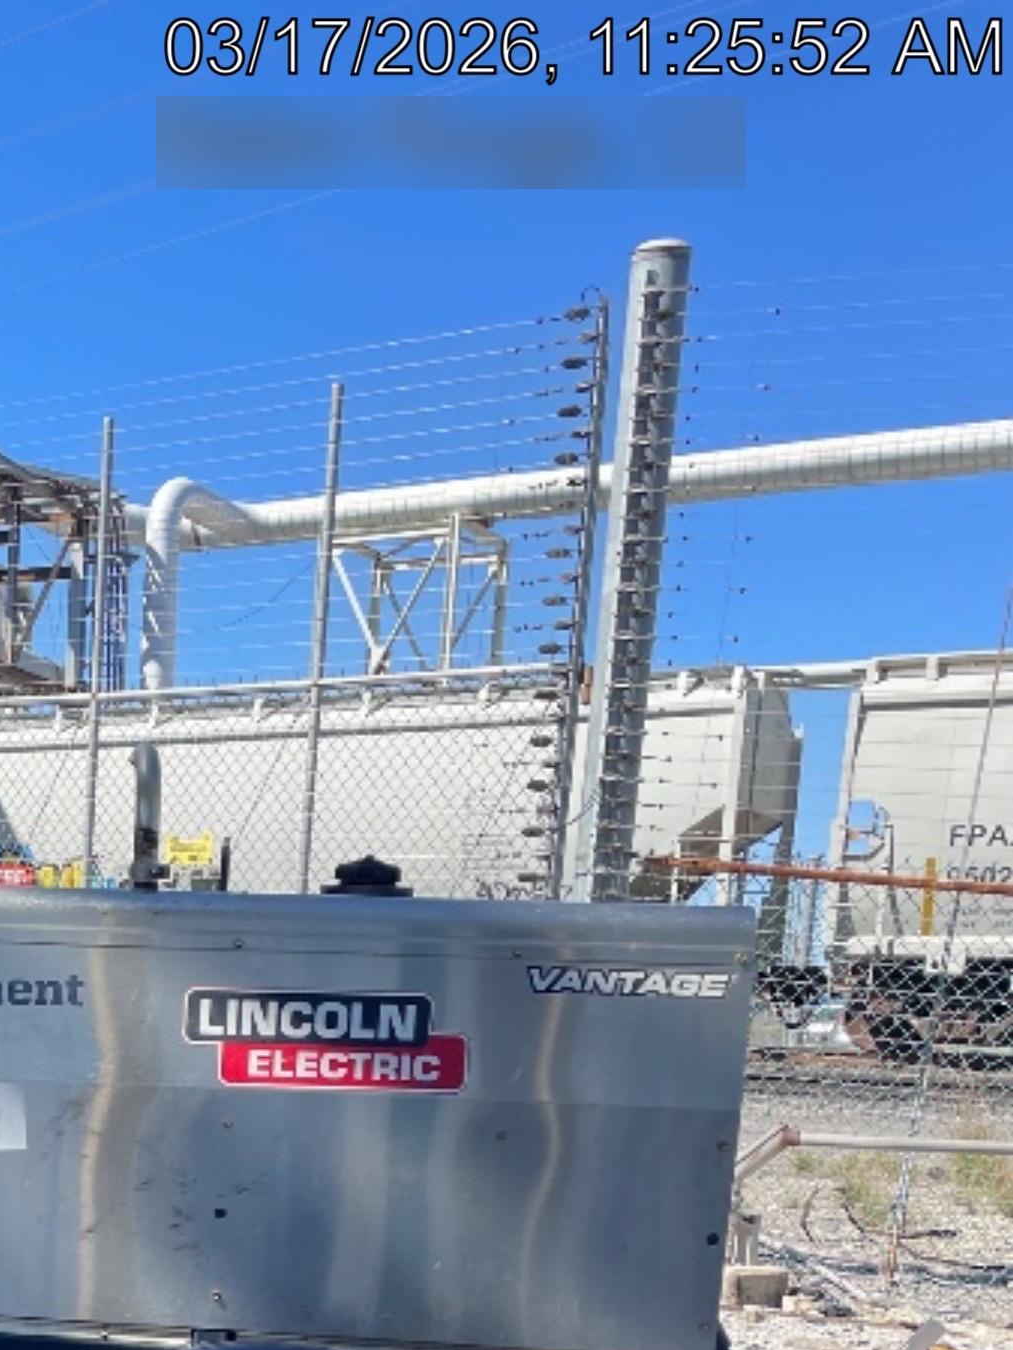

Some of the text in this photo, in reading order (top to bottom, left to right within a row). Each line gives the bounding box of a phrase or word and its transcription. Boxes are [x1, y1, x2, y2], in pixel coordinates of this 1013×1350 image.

[949, 824, 1013, 847] FPA
[528, 965, 730, 998] VANTAGE
[199, 998, 418, 1041] LINCOLN
[247, 1050, 442, 1081] ELECTRIC
